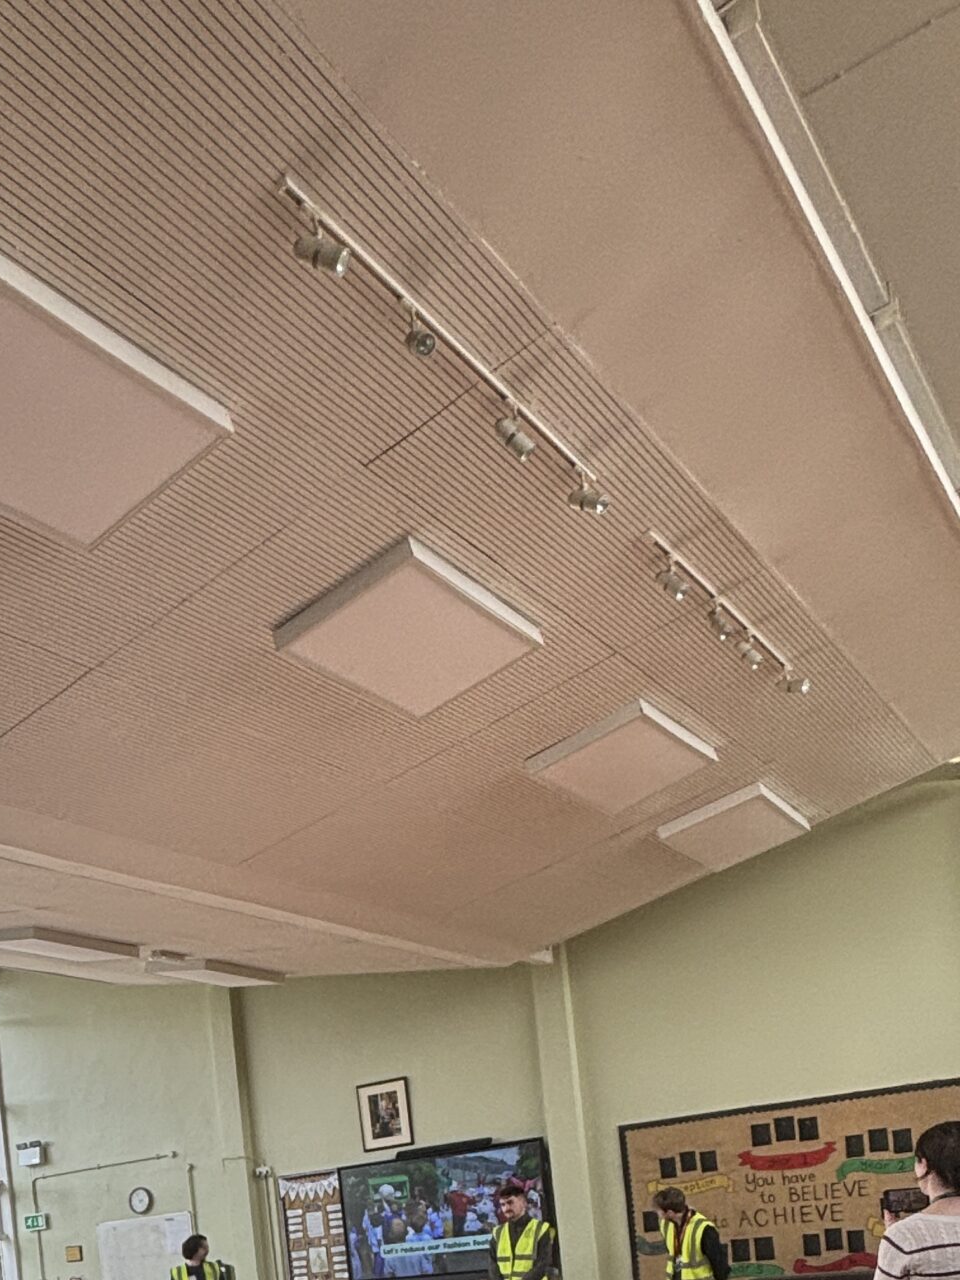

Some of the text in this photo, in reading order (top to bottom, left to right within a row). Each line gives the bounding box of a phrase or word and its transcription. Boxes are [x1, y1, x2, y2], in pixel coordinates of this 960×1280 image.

[781, 1169, 816, 1186] have
[760, 1180, 870, 1204] to BELIEVE
[739, 1203, 844, 1228] ACHIEVE
